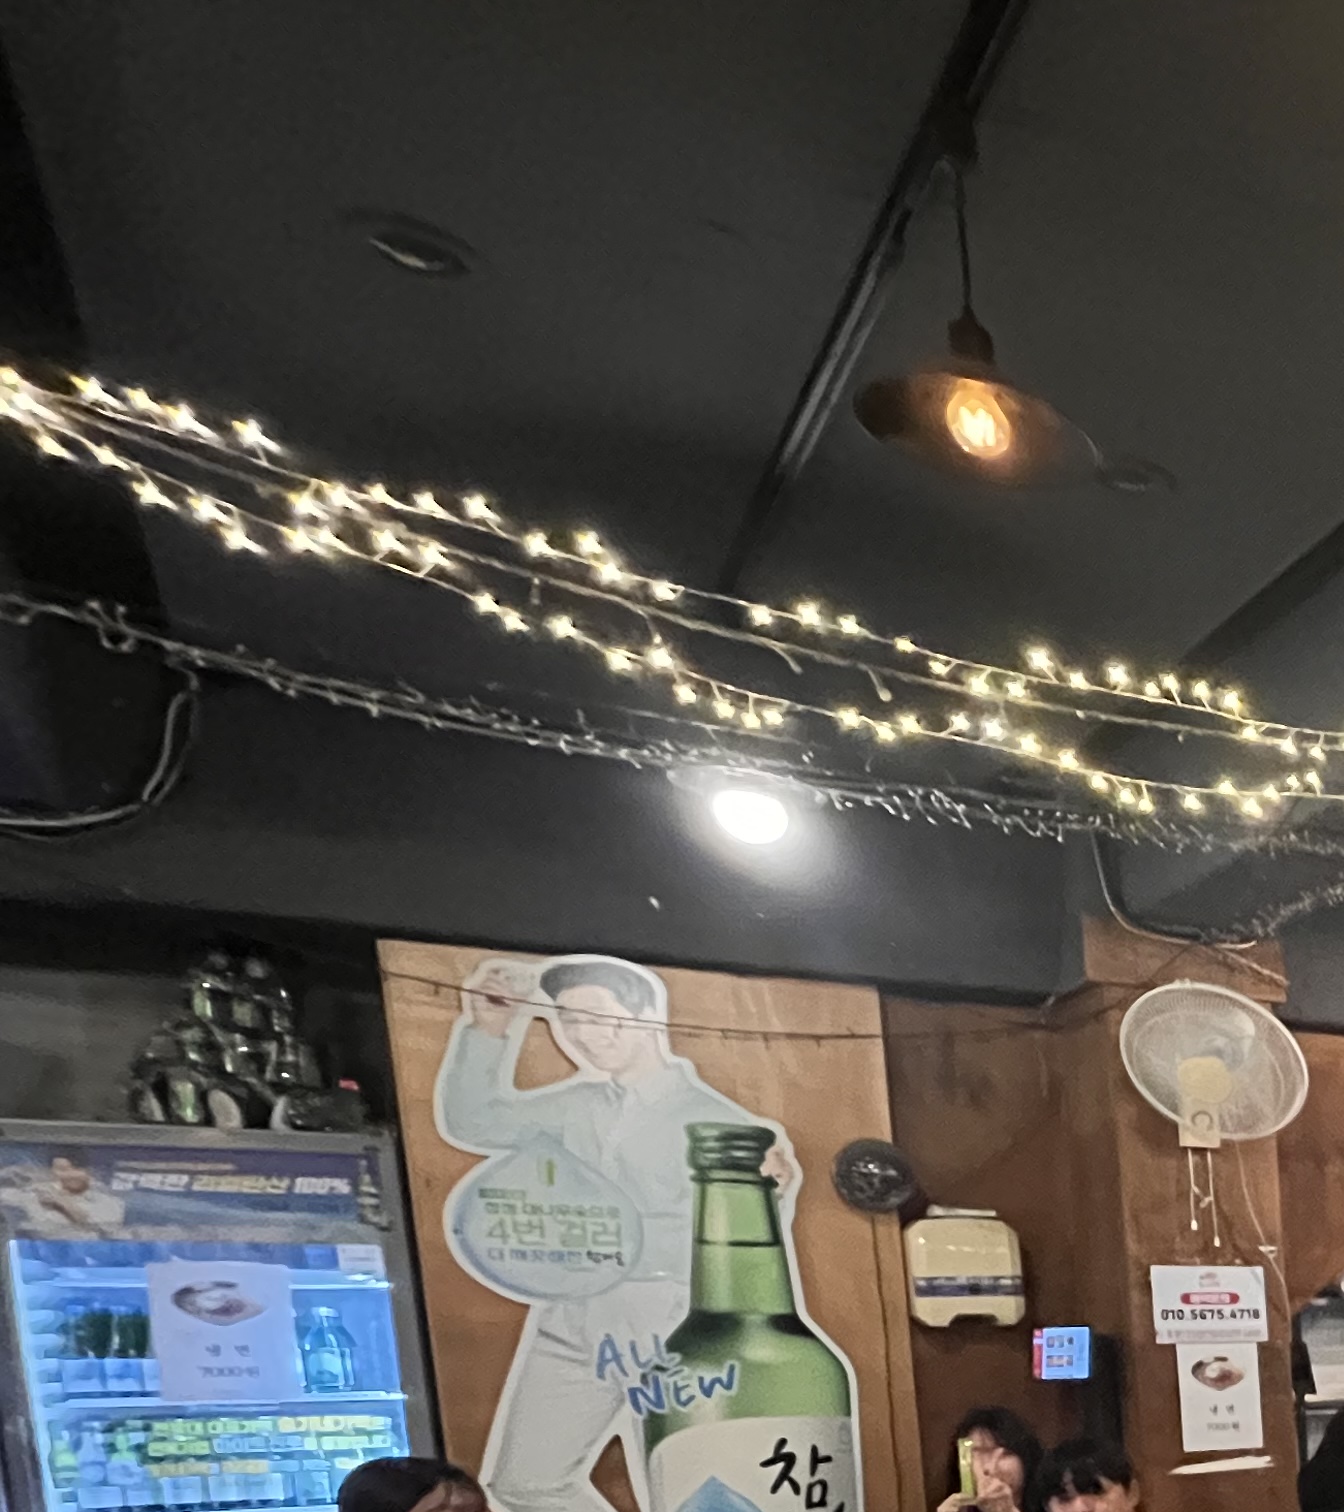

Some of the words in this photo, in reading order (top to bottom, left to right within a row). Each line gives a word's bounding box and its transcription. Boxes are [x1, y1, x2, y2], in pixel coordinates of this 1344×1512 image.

[487, 1216, 548, 1247] 4번
[595, 1333, 682, 1381] ALL
[627, 1363, 736, 1416] NEW
